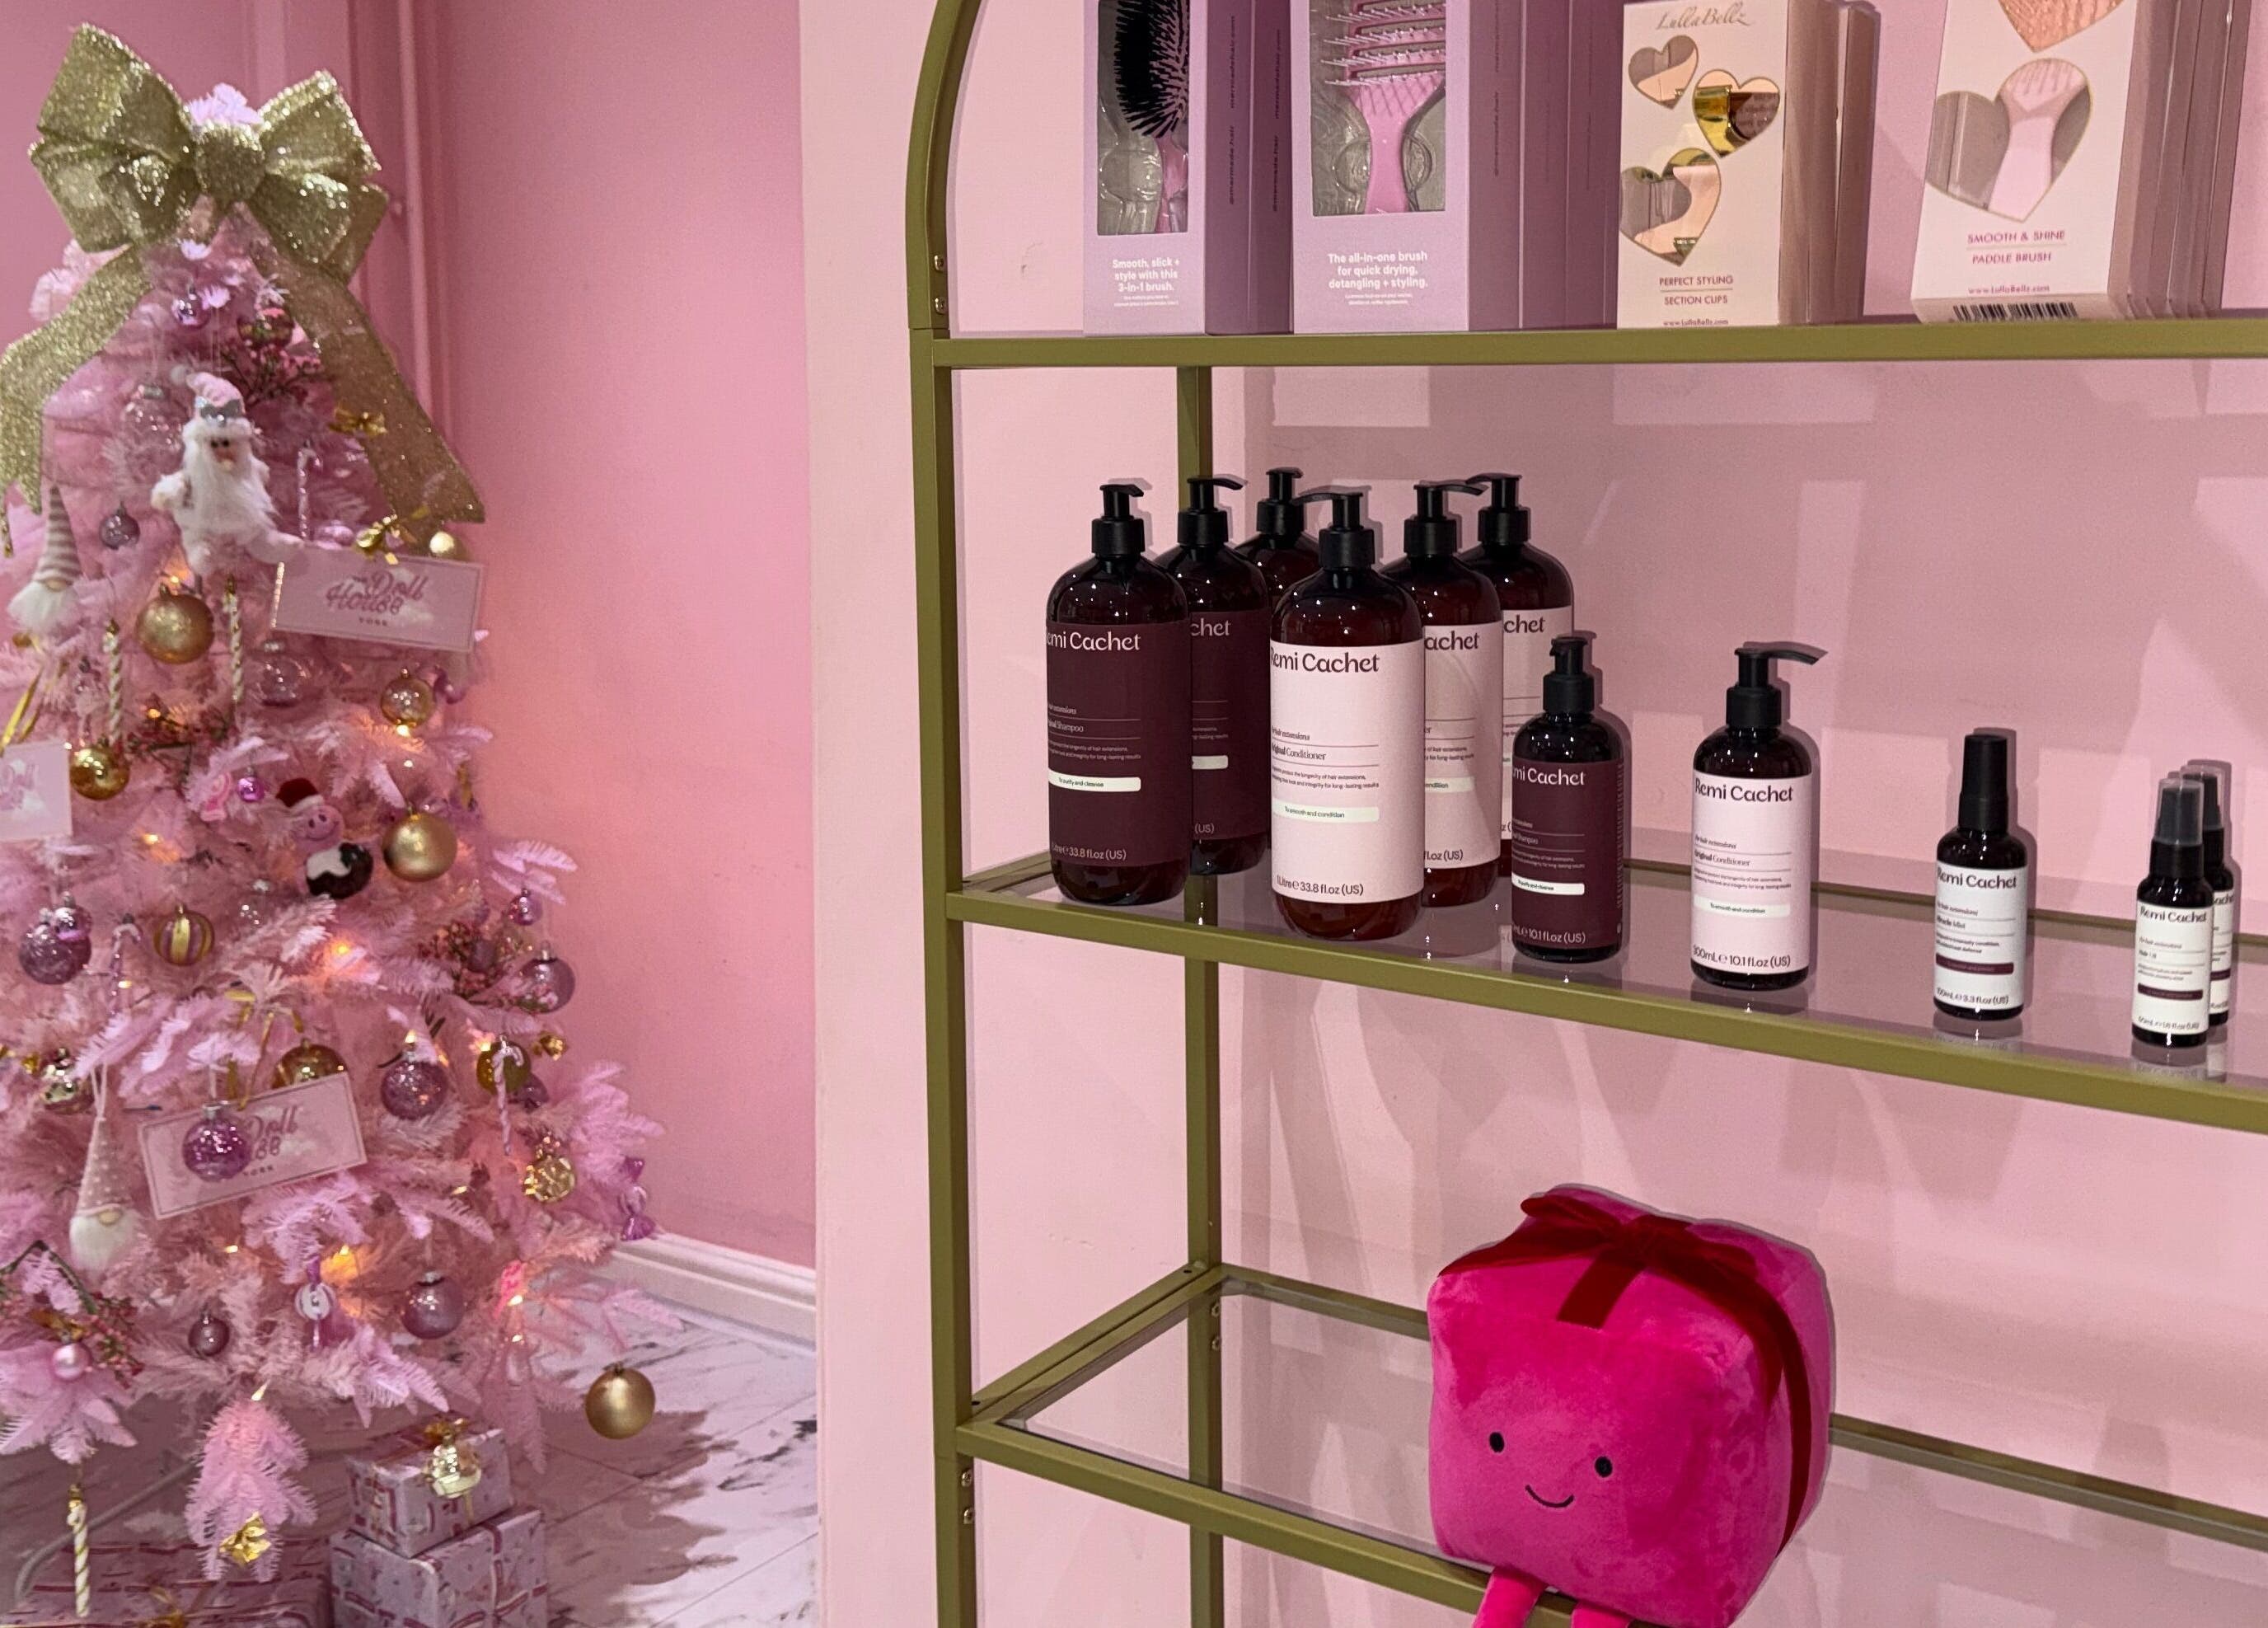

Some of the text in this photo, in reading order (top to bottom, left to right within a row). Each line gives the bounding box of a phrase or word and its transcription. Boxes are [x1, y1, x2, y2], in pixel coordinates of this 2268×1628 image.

[1967, 230, 2064, 244] SMOOTH & SHINE
[1152, 256, 1172, 267] slick
[1327, 250, 1428, 264] The all-in-one brush
[1972, 252, 2051, 265] PADDLE BRUSH
[1114, 268, 1179, 281] style with this
[1338, 265, 1352, 276] for
[1353, 265, 1381, 277] quick
[1118, 280, 1174, 293] 3-in-1 brush.
[1328, 278, 1380, 290] detangling
[1659, 274, 1733, 286] PERFECT STYLING
[1664, 295, 1728, 306] SECTION CLIPS
[1191, 618, 1231, 637] chet
[1503, 615, 1546, 634] chet
[1047, 631, 1141, 651] emi Cachet
[1424, 631, 1479, 651] achet
[1302, 652, 1380, 673] Cachet
[1286, 748, 1327, 761] Conditioner
[1527, 767, 1586, 786] Cachet
[1694, 777, 1793, 803] Remi Cachet
[1195, 823, 1215, 834] (US)
[1106, 849, 1127, 861] (US)
[1443, 849, 1464, 862] (US)
[1300, 881, 1319, 894] 33.8
[1342, 883, 1364, 896] (US)
[1966, 875, 2017, 889] Cachet
[2139, 905, 2207, 923] Remi Cachet
[1564, 931, 1586, 945] (US)
[1730, 955, 1746, 966] 10.1
[1770, 955, 1791, 969] (US)
